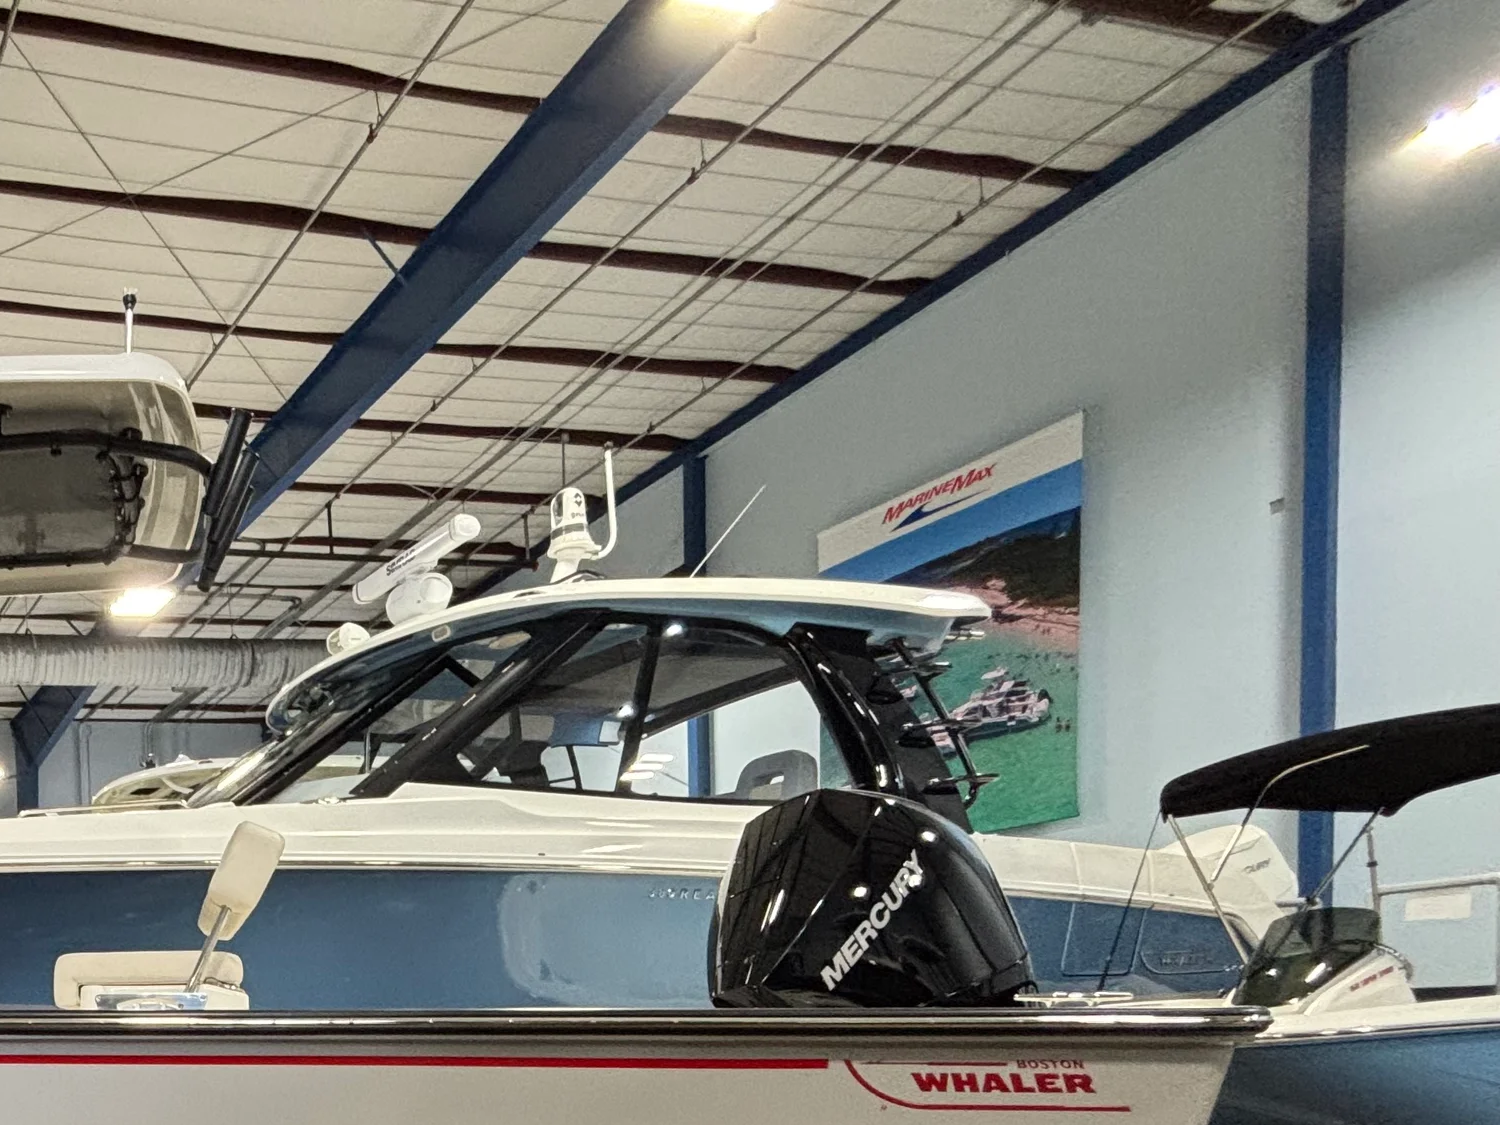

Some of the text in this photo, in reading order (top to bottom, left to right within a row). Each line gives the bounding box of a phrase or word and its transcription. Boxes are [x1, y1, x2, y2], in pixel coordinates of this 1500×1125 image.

[820, 848, 923, 991] MERCURY
[1017, 1059, 1085, 1069] BOSTON
[911, 1073, 1097, 1094] WHALER
